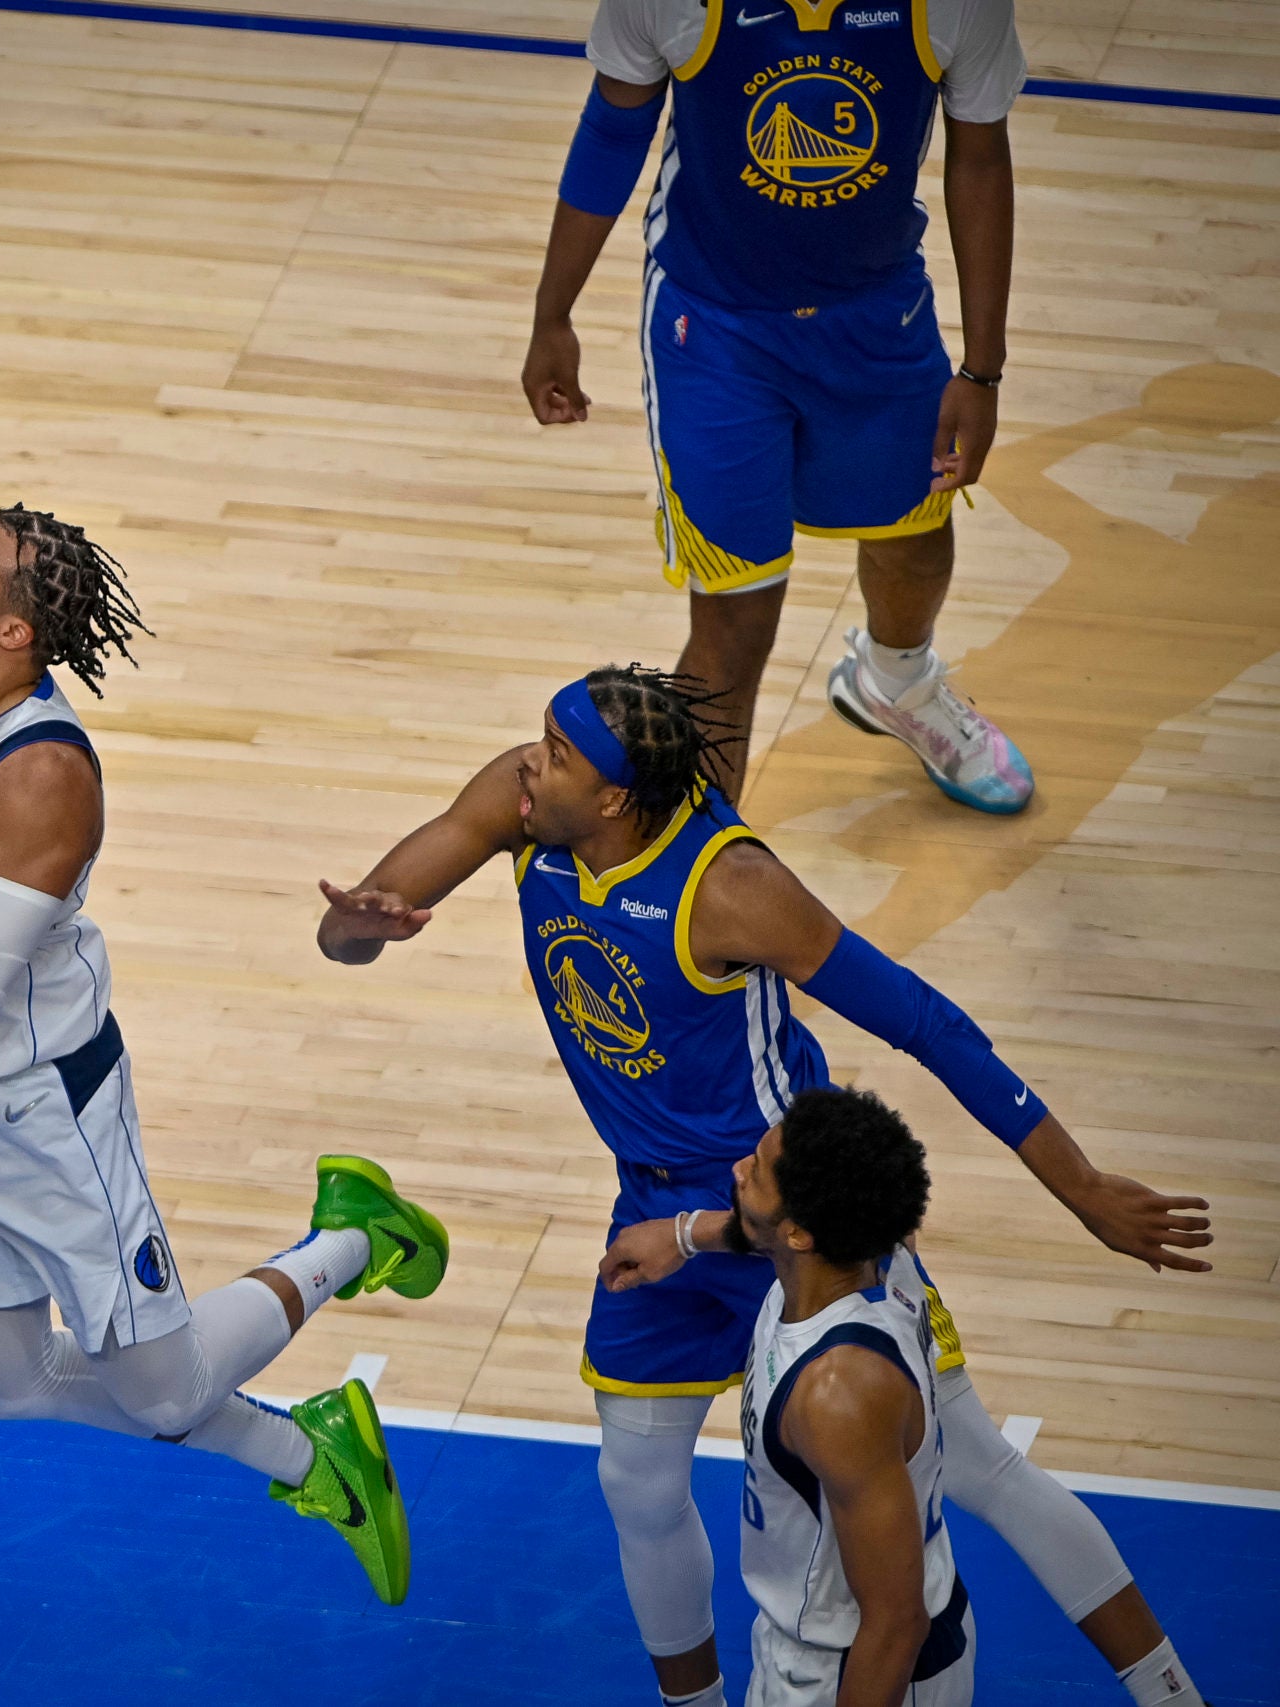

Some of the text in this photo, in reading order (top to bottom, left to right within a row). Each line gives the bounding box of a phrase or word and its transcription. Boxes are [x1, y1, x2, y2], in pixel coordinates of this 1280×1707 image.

[844, 8, 900, 27] Rakuten
[742, 54, 885, 97] GOLDEN STATE
[833, 101, 857, 135] 5
[739, 159, 890, 209] WARRIORS
[620, 897, 669, 921] Rakuten
[536, 914, 646, 989] GOLDEN STATE
[608, 982, 627, 1015] 4
[554, 1000, 667, 1080] WARRIORS
